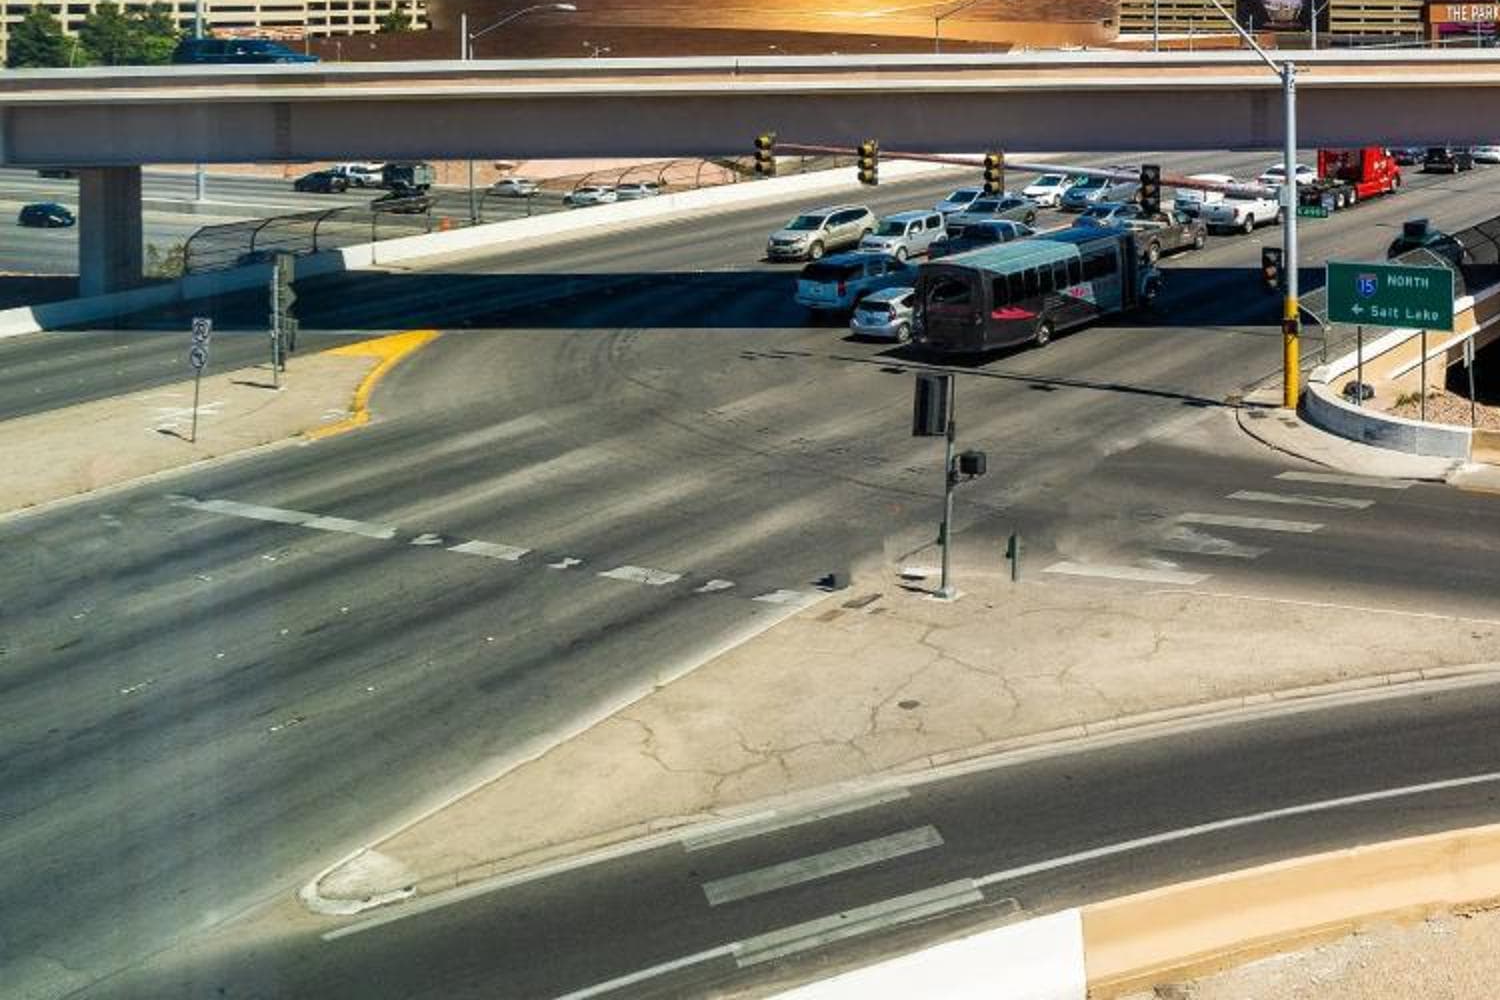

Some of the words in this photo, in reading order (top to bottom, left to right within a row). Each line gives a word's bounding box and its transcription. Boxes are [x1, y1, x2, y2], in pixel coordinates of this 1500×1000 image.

[1447, 5, 1468, 21] THE
[1471, 5, 1500, 21] PARK
[1360, 279, 1374, 293] 15
[1387, 274, 1429, 290] NORTH
[1371, 305, 1399, 319] Salt
[1405, 307, 1439, 322] Lake
